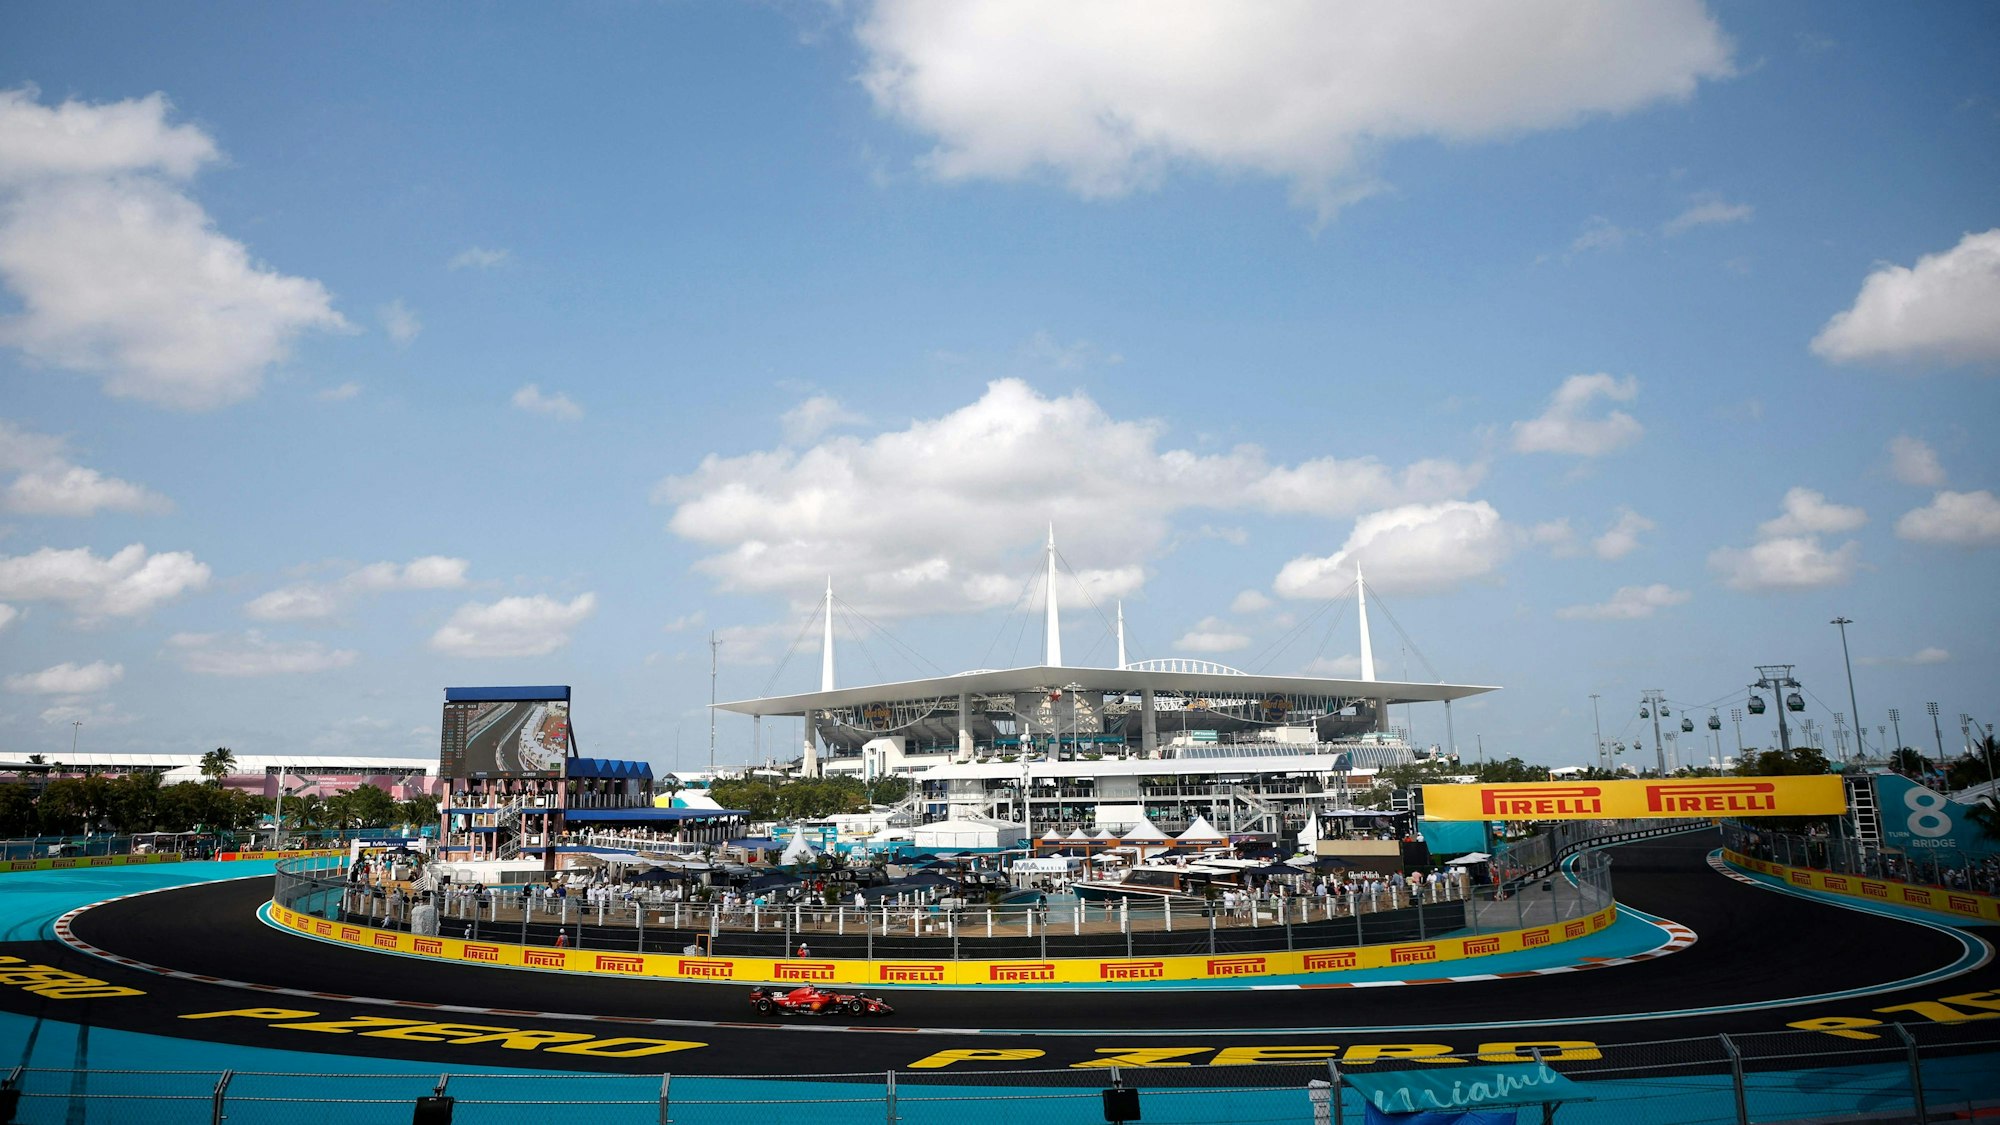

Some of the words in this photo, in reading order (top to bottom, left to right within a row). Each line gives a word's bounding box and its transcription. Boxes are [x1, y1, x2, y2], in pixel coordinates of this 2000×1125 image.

[1482, 788, 1601, 815] PIRELLI
[1646, 783, 1776, 812] PIRELLI
[1904, 786, 1952, 838] 8
[1912, 838, 1956, 848] BRIDGE
[11, 861, 37, 870] PIRELLI
[52, 859, 76, 868] PIRELLI
[91, 857, 113, 866] PIRELLI
[1014, 862, 1039, 871] MIA
[1824, 877, 1848, 891] PIRELLI
[1862, 882, 1888, 898] PIRELLI
[1903, 888, 1931, 905] PIRELLI
[1949, 895, 1980, 914] PIRELLI
[342, 927, 361, 942] PIRELLI
[374, 933, 398, 949] PIRELLI
[1522, 929, 1550, 947] PIRELLI
[414, 939, 442, 954] PIRELLI
[464, 944, 499, 961] PIRELLI
[1391, 944, 1437, 963] PIRELLI
[1463, 937, 1500, 955] PIRELLI
[524, 950, 565, 967] PIRELLI
[596, 955, 644, 973] PIRELLI
[1208, 957, 1266, 976] PIRELLI
[1304, 951, 1357, 970] PIRELLI
[679, 959, 733, 977] PIRELLI
[774, 963, 835, 980] PIRELLI
[880, 965, 944, 981] PIRELLI
[990, 964, 1055, 980] PIRELLI
[1100, 961, 1164, 978] PIRELLI
[178, 1007, 320, 1020] P
[268, 1016, 709, 1058] ZERO
[907, 1048, 1047, 1069] P
[1069, 1041, 1604, 1069] ZERO
[1375, 1065, 1557, 1113] Miami
